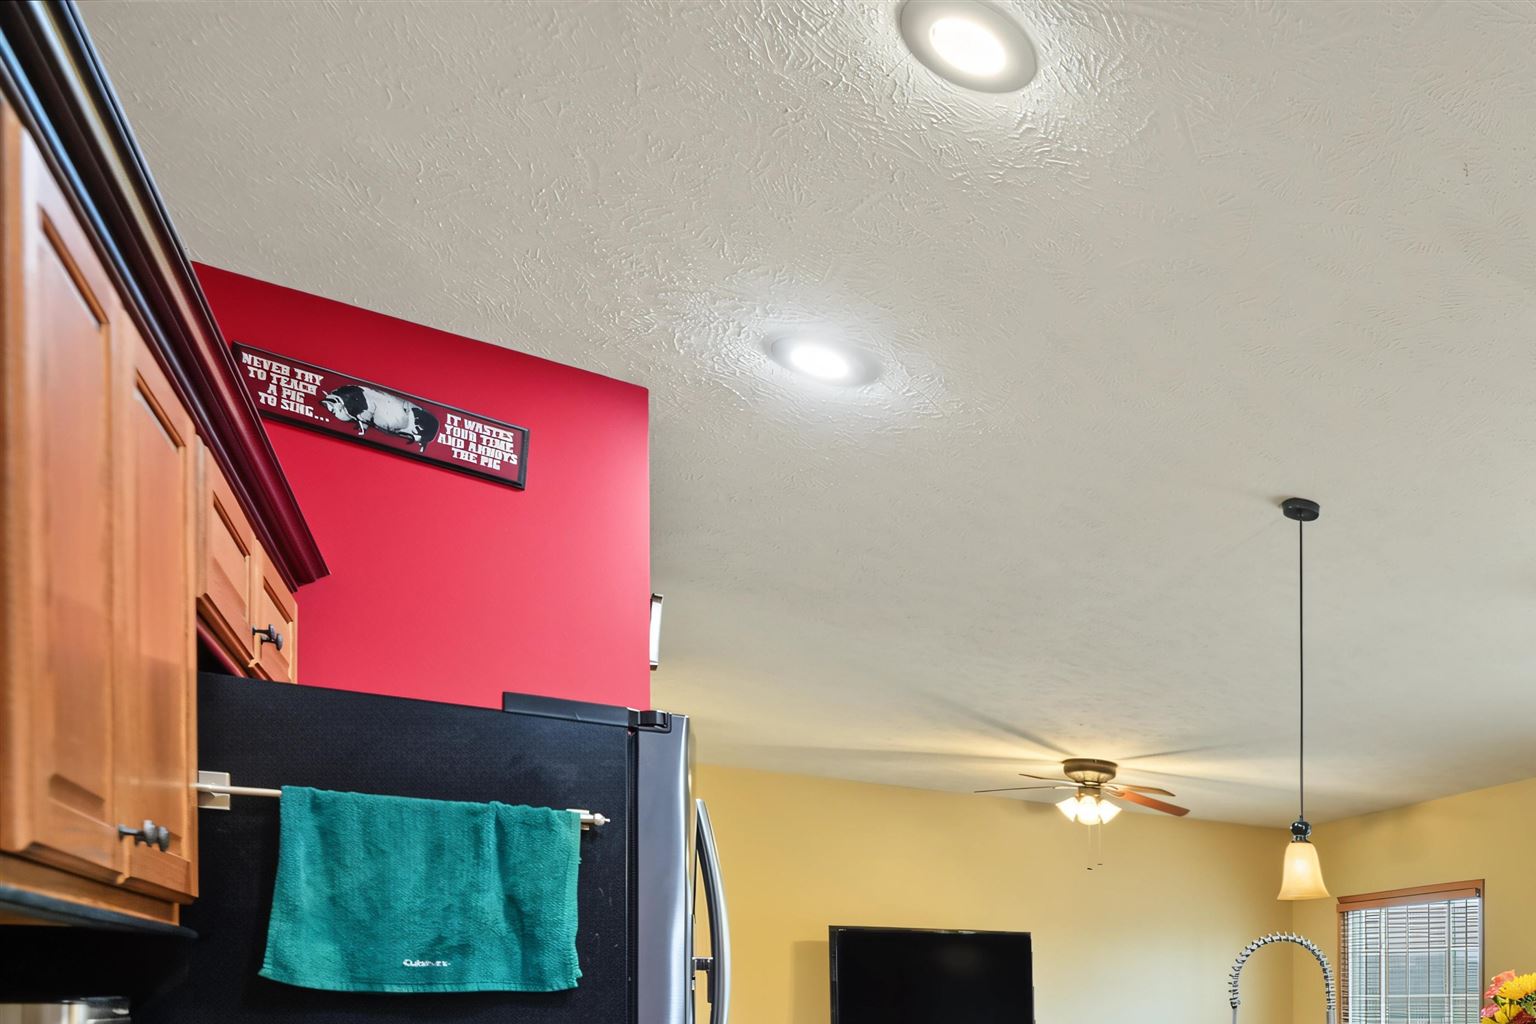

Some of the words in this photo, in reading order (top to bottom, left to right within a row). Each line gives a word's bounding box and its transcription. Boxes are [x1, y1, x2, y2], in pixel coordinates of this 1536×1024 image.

[241, 351, 291, 376] NEVER
[293, 367, 324, 386] TRY
[247, 365, 267, 381] TO
[269, 372, 318, 396] TEACH
[258, 391, 277, 407] TO
[266, 383, 278, 396] A
[281, 387, 305, 403] PIG
[444, 423, 477, 443] YOUR
[479, 434, 514, 454] TIME
[446, 413, 462, 427] IT
[463, 418, 514, 443] WASTES
[437, 432, 465, 449] AND
[468, 441, 518, 465] ANNOYS
[451, 447, 478, 465] THE
[480, 455, 501, 471] PIG
